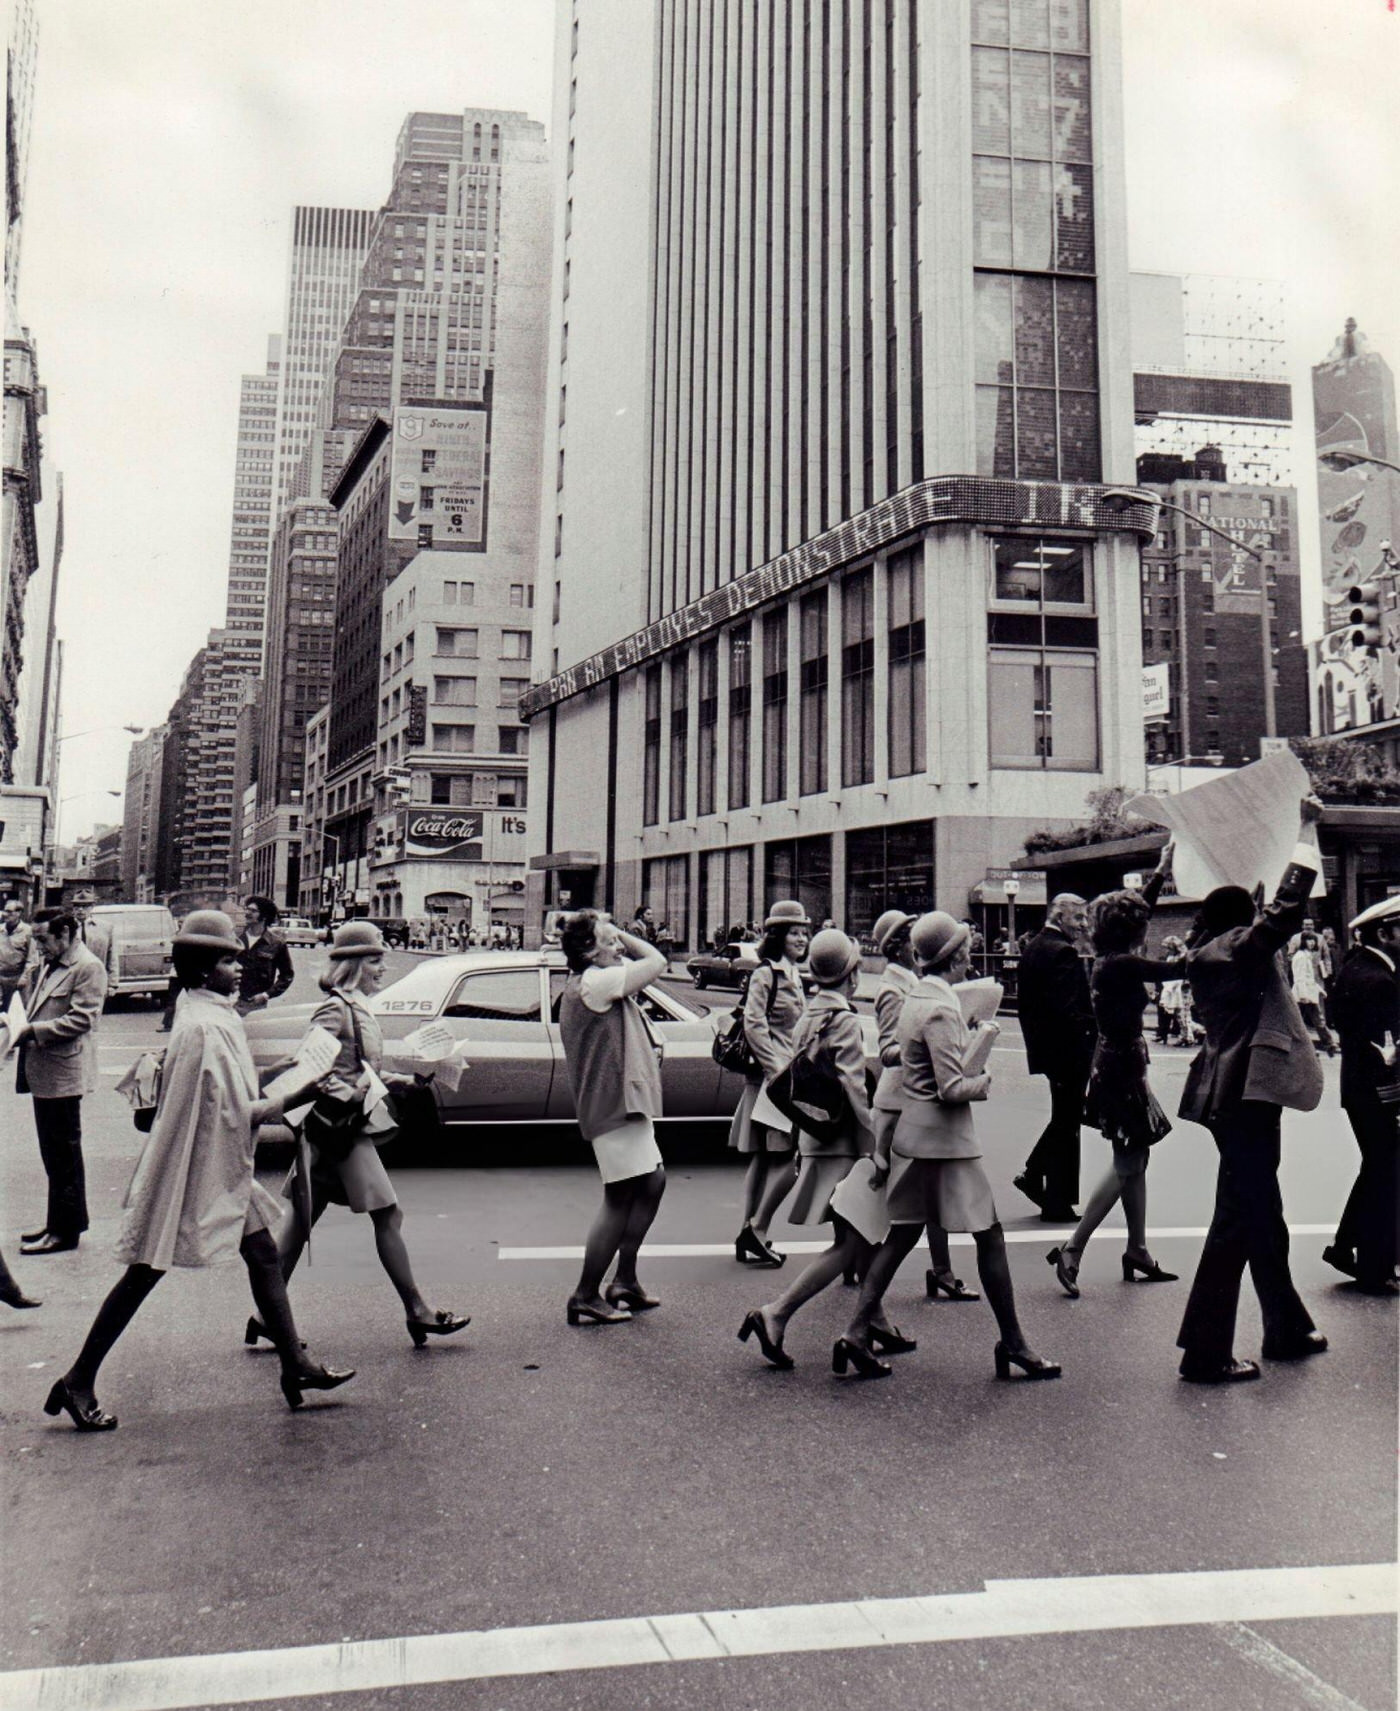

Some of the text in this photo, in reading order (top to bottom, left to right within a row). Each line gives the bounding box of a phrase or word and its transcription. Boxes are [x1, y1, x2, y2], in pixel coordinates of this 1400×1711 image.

[429, 418, 453, 429] Save
[440, 497, 475, 505] FRIDAYS
[451, 514, 463, 526] 6
[549, 670, 577, 703] PAN
[613, 596, 714, 672] EMPLOYES
[726, 477, 956, 617] DEMONSTRATE
[410, 817, 478, 838] Coca-Cola
[502, 816, 527, 834] It's
[381, 1000, 433, 1011] 1276
